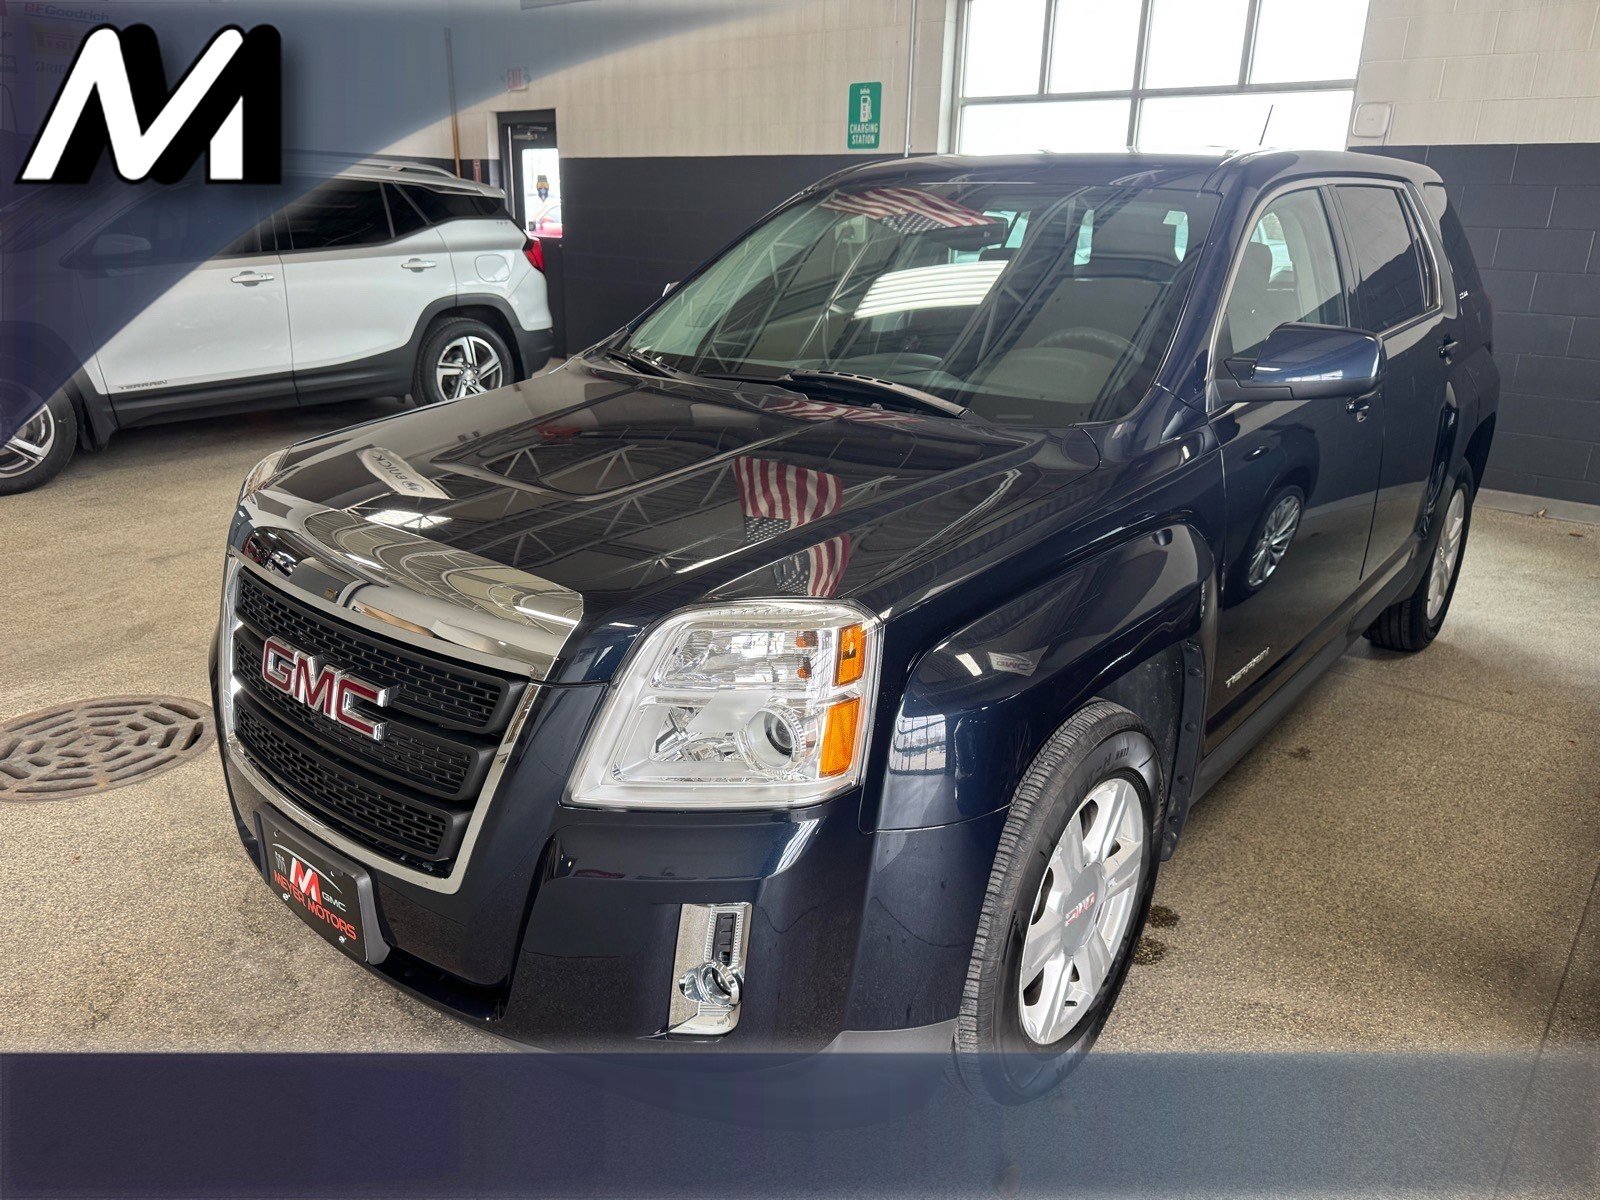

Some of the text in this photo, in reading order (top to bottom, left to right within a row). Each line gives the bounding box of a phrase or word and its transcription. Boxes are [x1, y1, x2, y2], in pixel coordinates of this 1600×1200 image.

[24, 2, 110, 21] BFGoodrich
[850, 123, 878, 134] CHARGING
[852, 134, 876, 144] STATION
[262, 635, 390, 742] GMC
[273, 869, 357, 940] MEYER MOTORS
[322, 891, 347, 912] GMC
